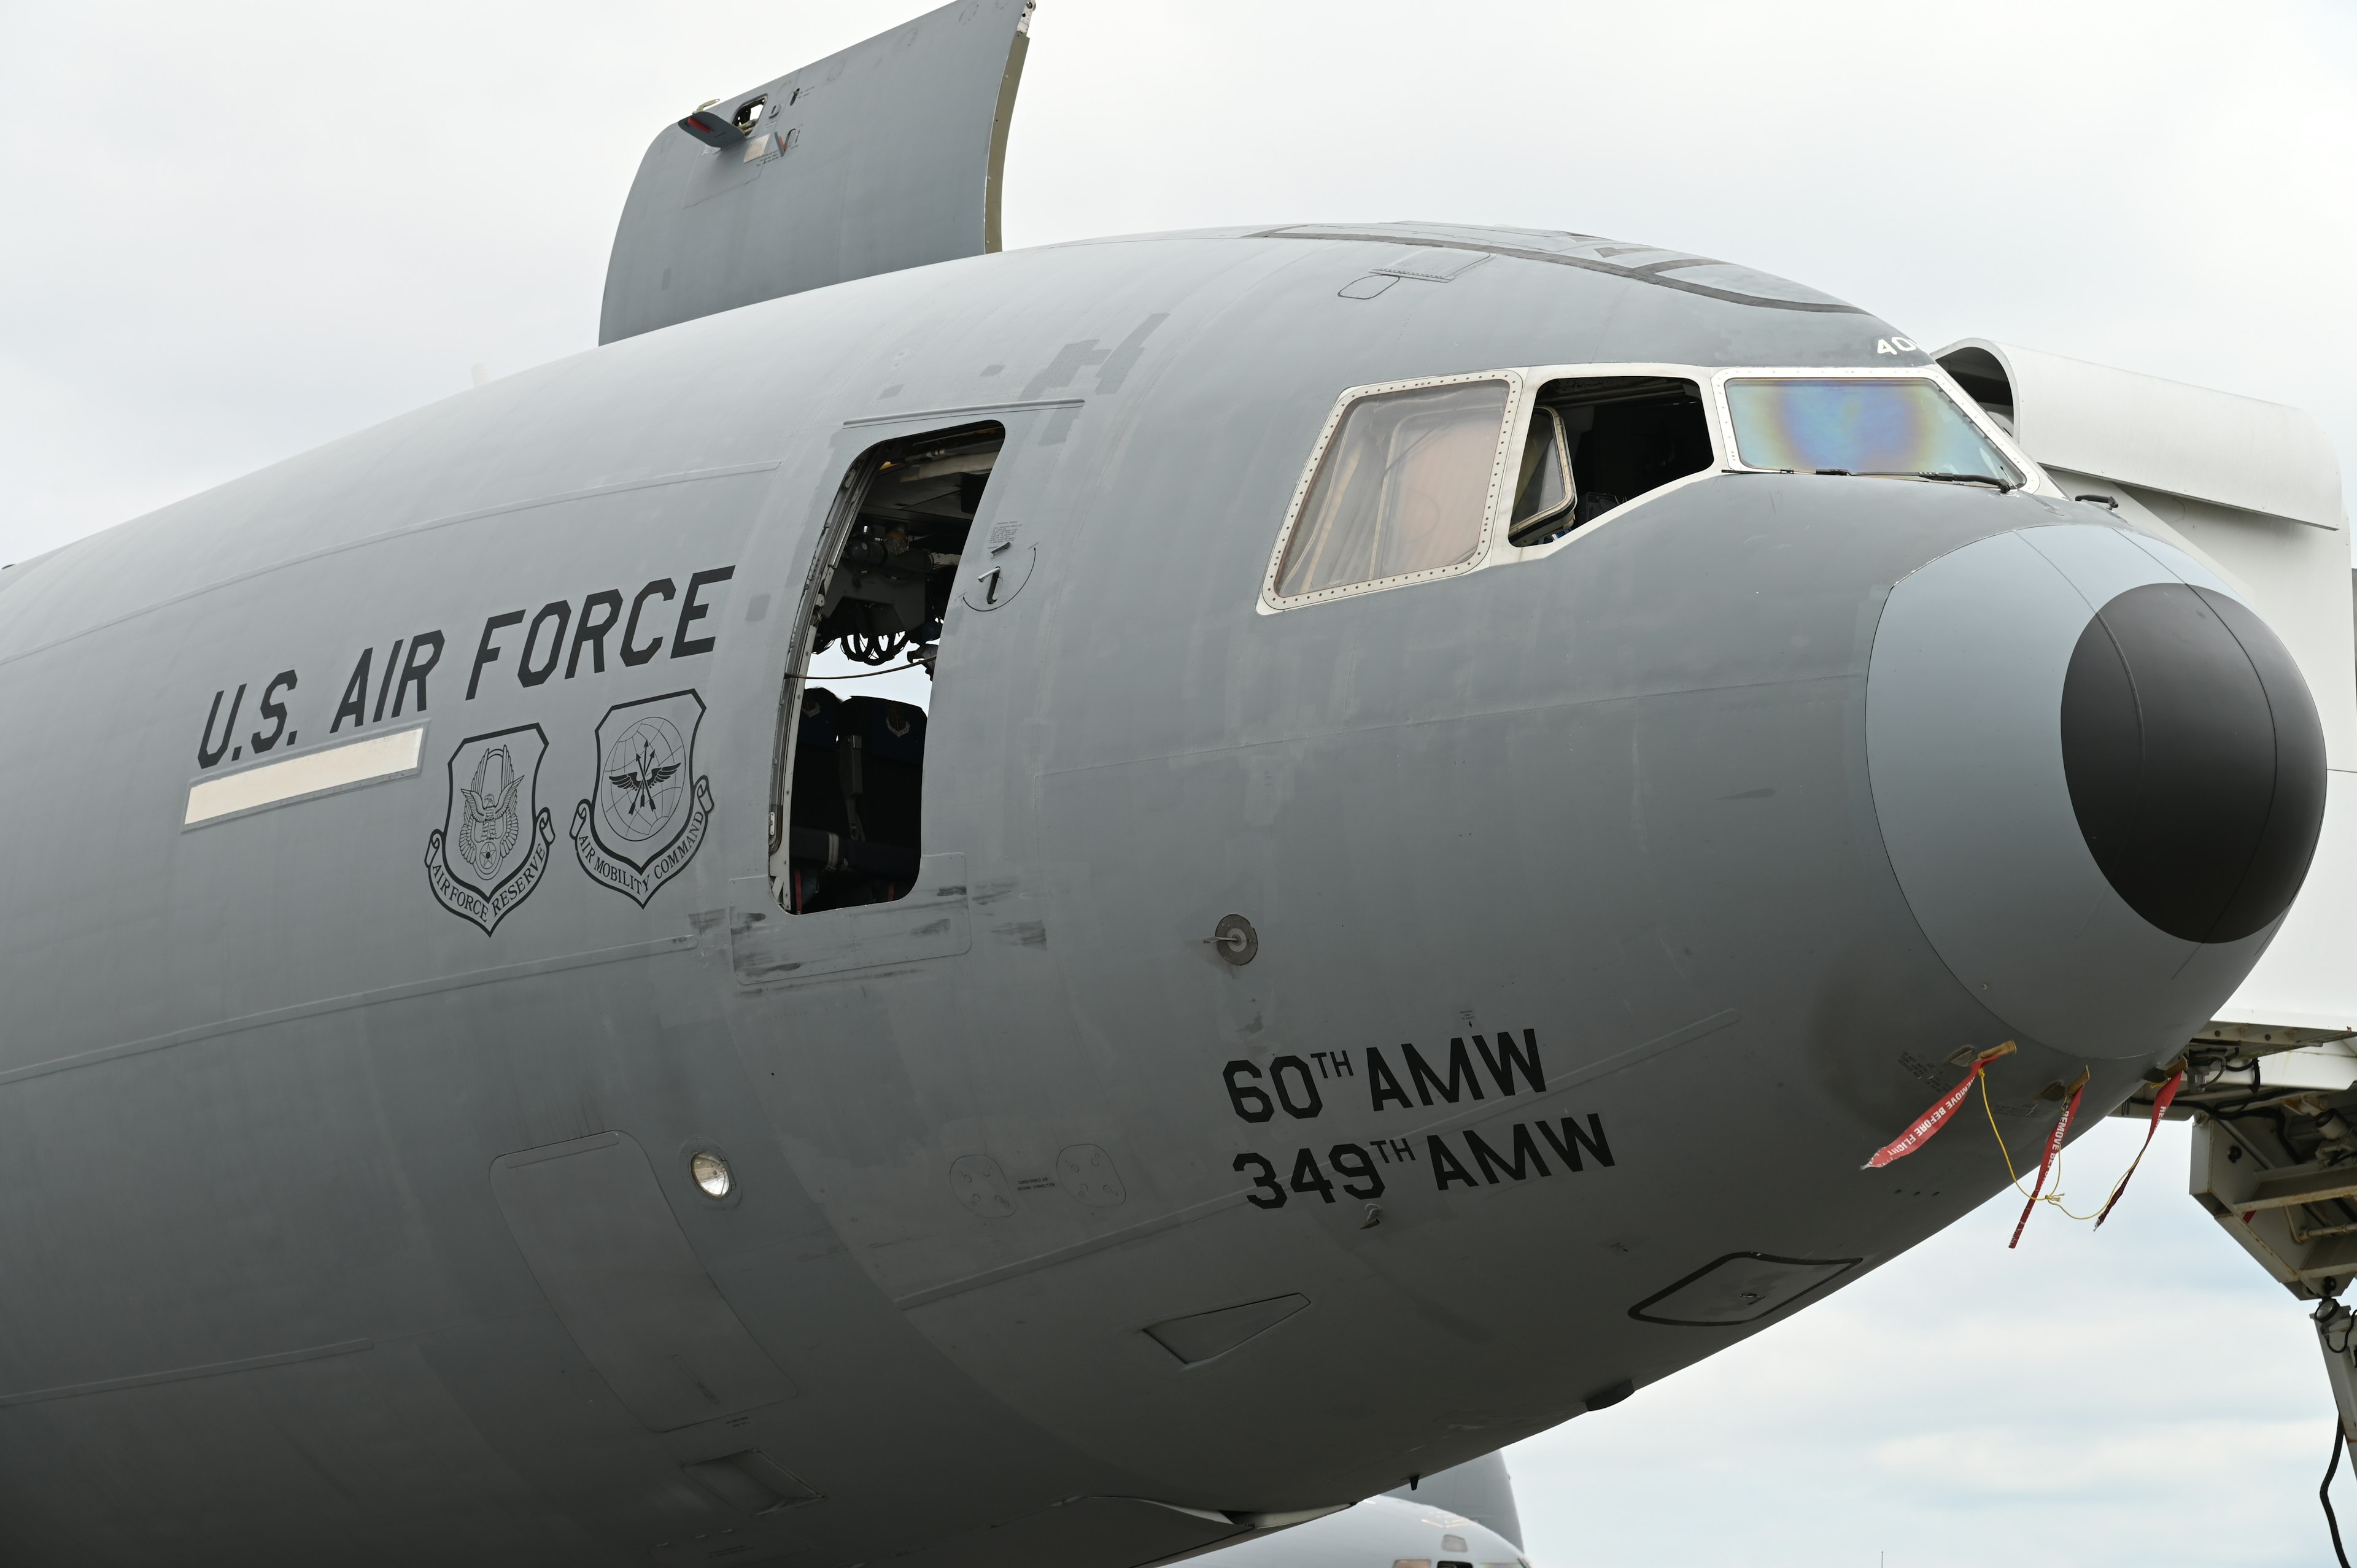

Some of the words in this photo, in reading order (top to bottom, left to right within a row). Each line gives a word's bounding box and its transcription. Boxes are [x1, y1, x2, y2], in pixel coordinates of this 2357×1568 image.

[1877, 336, 1922, 355] 40
[197, 669, 298, 769] U.S.
[330, 630, 446, 733] AIR
[465, 565, 736, 701] FORCE
[432, 865, 451, 896] AIR
[449, 888, 489, 922] FORCE
[491, 843, 546, 917] RESERVE
[579, 835, 595, 863] AIR
[594, 856, 650, 895] MOBILITY
[654, 811, 703, 879] COMMAND
[1366, 1028, 1547, 1111] AMW
[1426, 1113, 1616, 1191] AMW
[1887, 1134, 1916, 1156] FLIGHT
[1914, 1106, 1946, 1137] BEFORE
